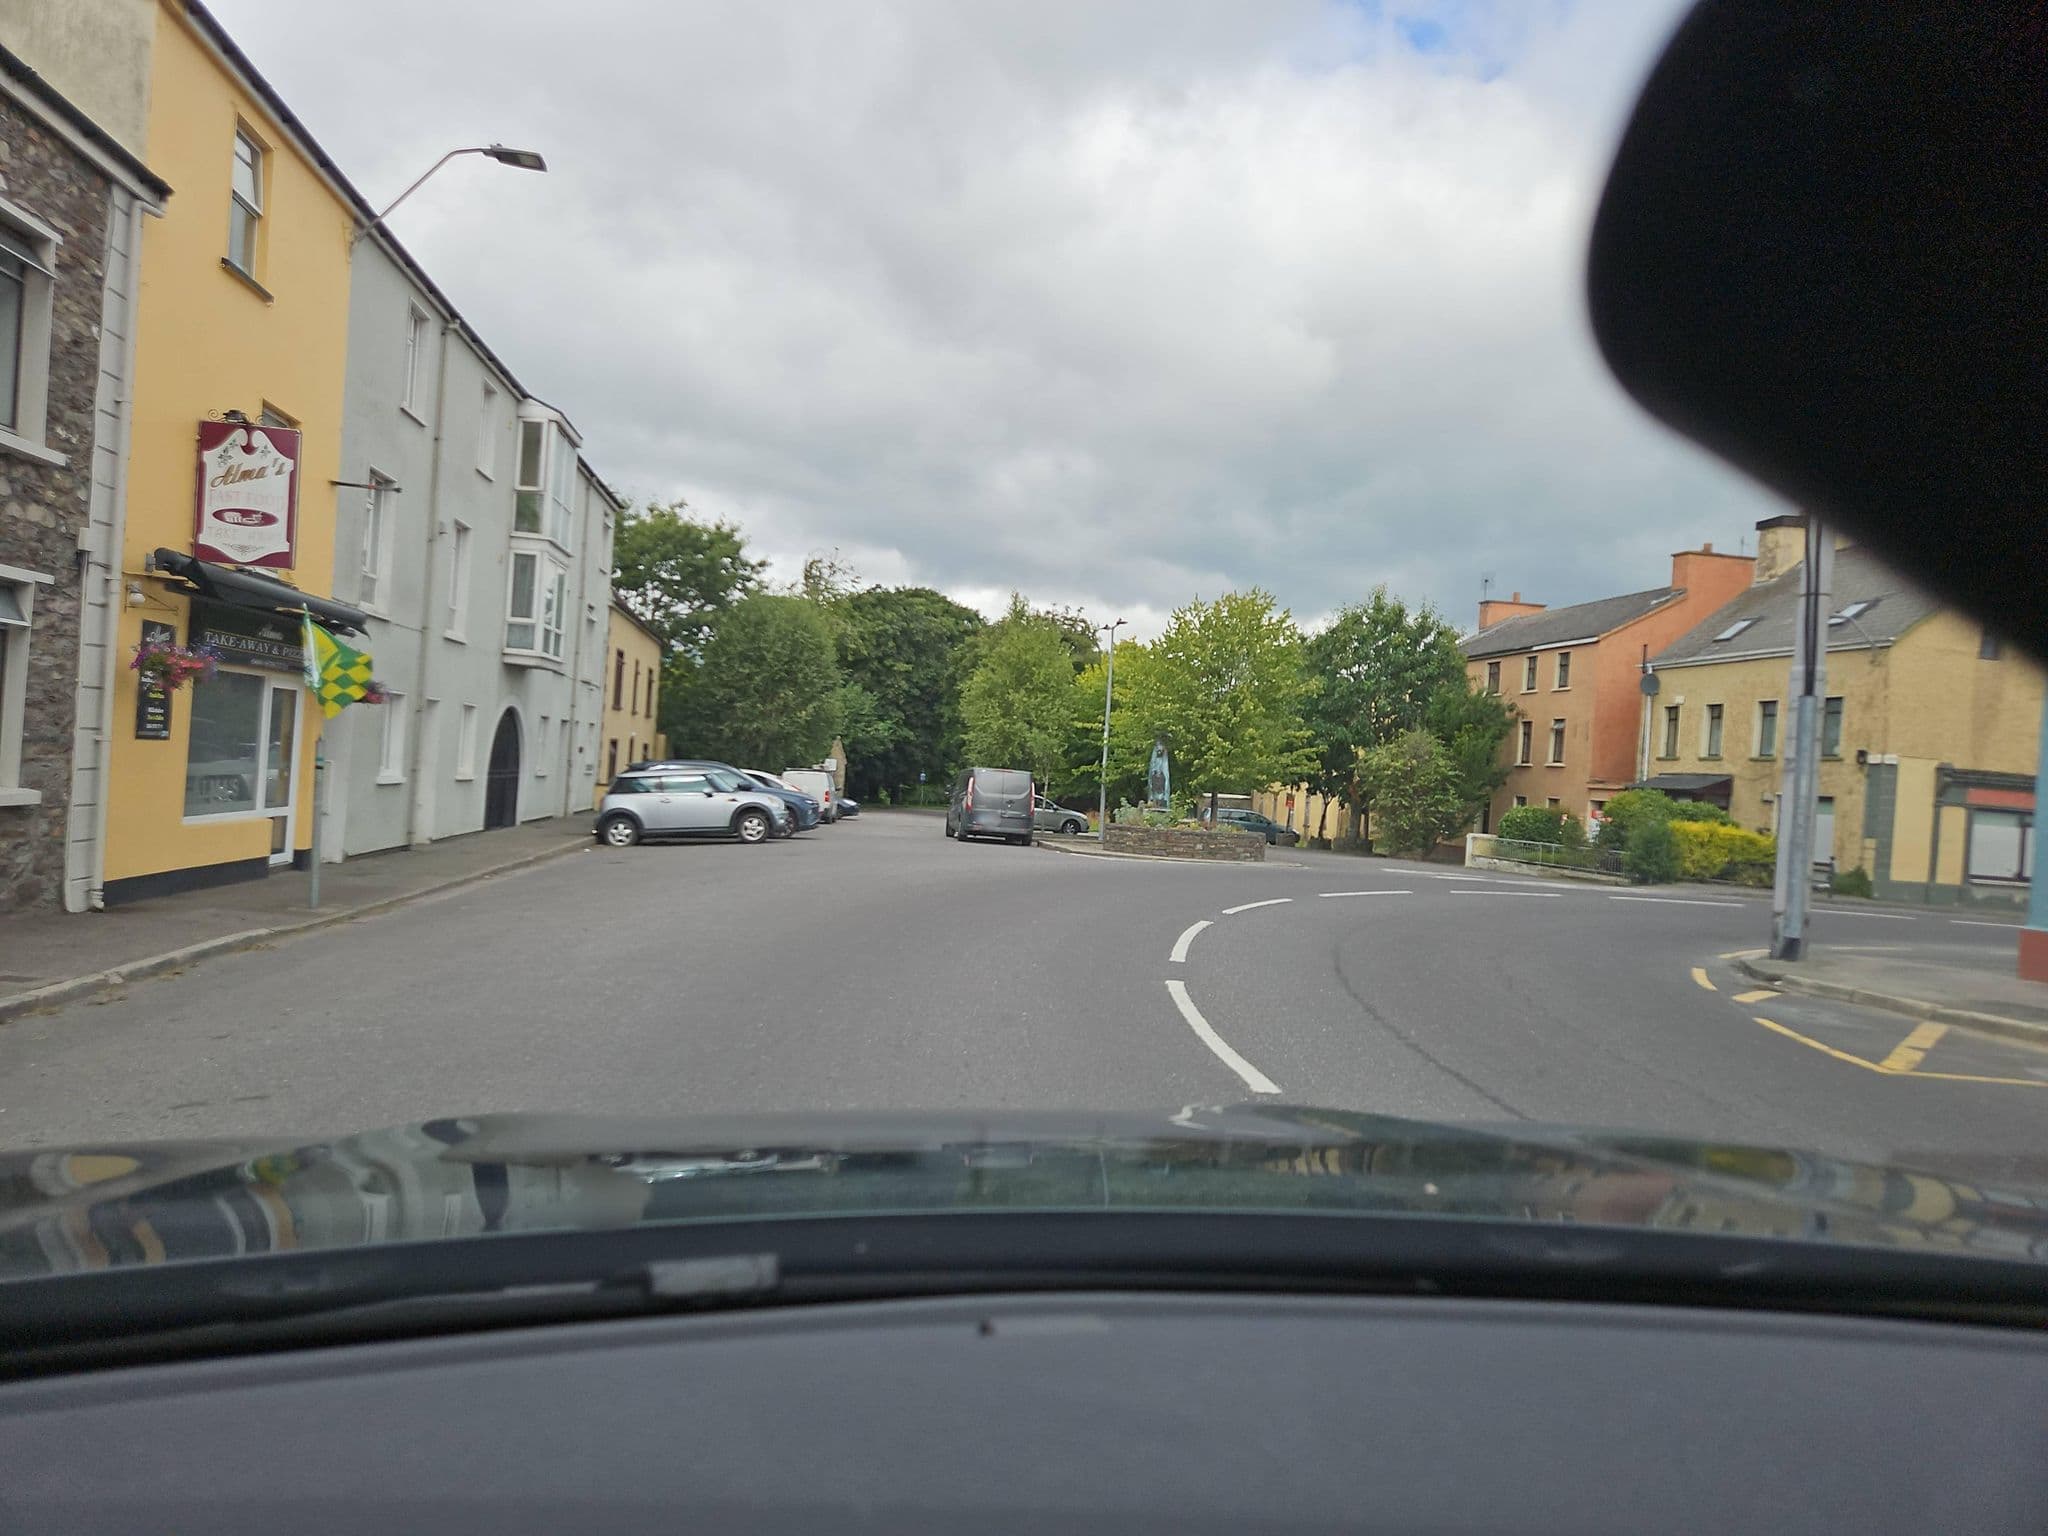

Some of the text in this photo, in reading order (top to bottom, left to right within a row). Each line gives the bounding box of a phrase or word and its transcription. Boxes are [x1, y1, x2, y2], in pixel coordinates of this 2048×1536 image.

[210, 456, 287, 488] Alma's
[204, 631, 271, 653] TAKE-AWAY
[282, 646, 304, 659] PIZZ
